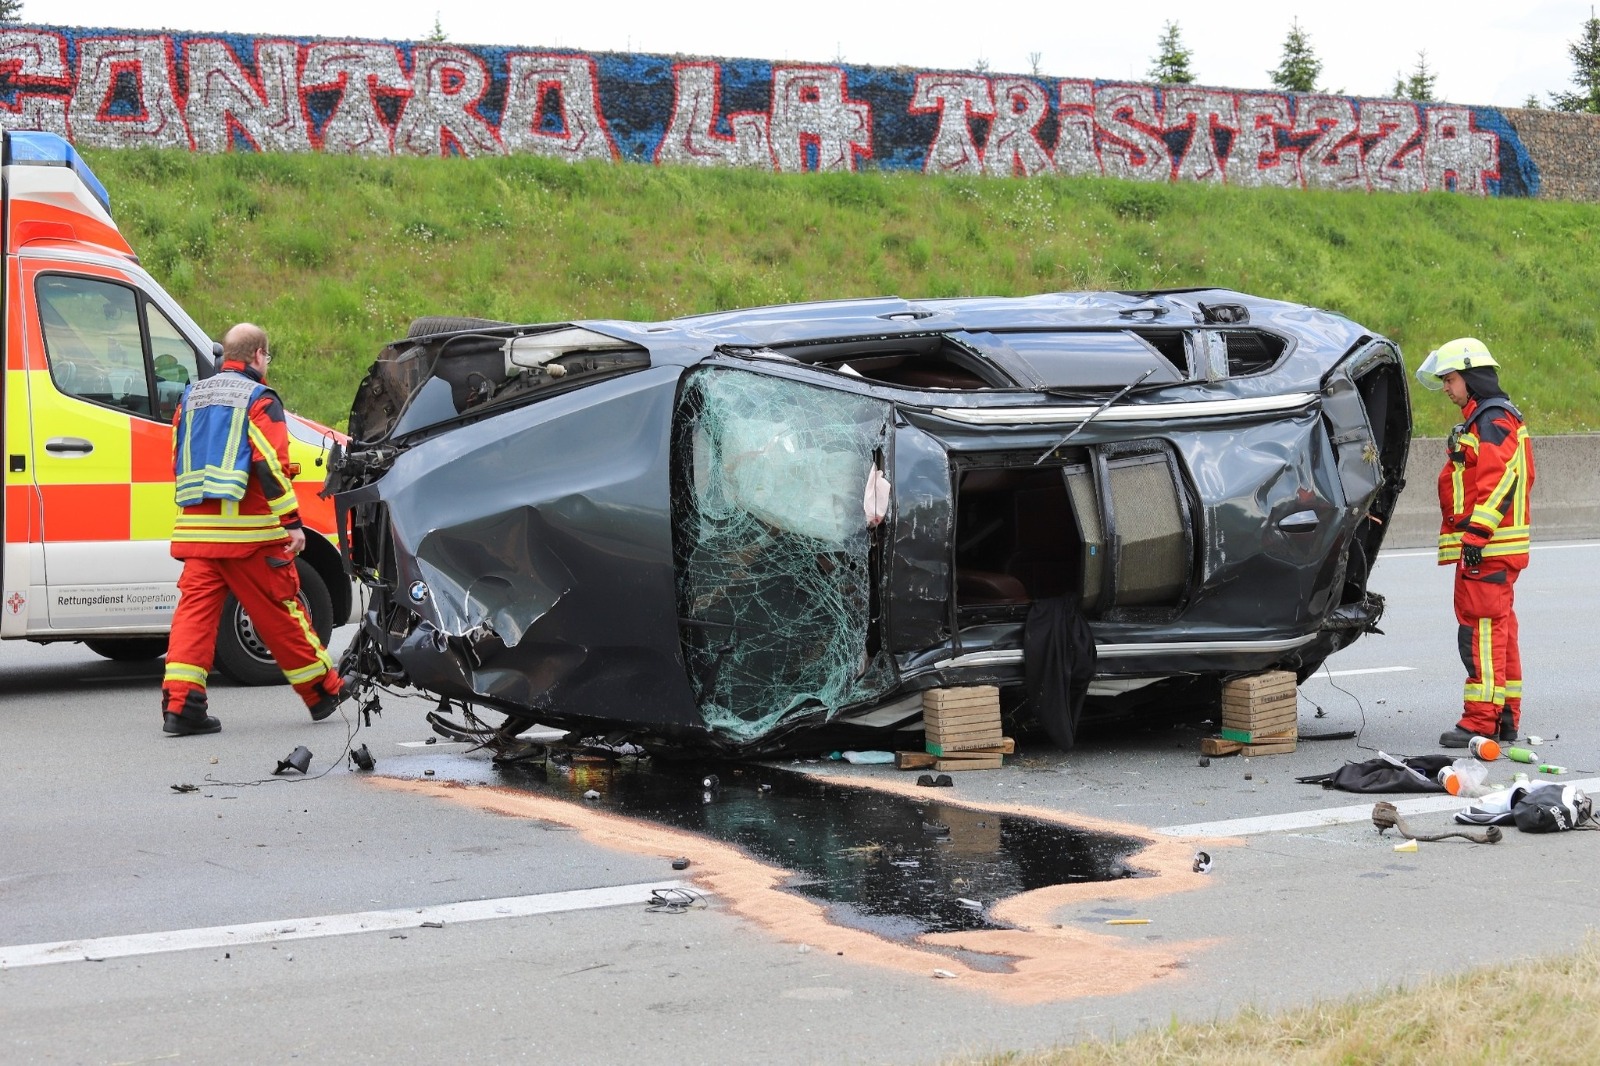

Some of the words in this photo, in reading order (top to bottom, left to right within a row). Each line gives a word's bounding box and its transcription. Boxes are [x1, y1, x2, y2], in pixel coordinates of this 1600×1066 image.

[654, 61, 873, 174] LA
[192, 379, 254, 390] FEUERWEHR
[57, 594, 124, 607] Rettungsdienst
[126, 593, 177, 605] Kooperation
